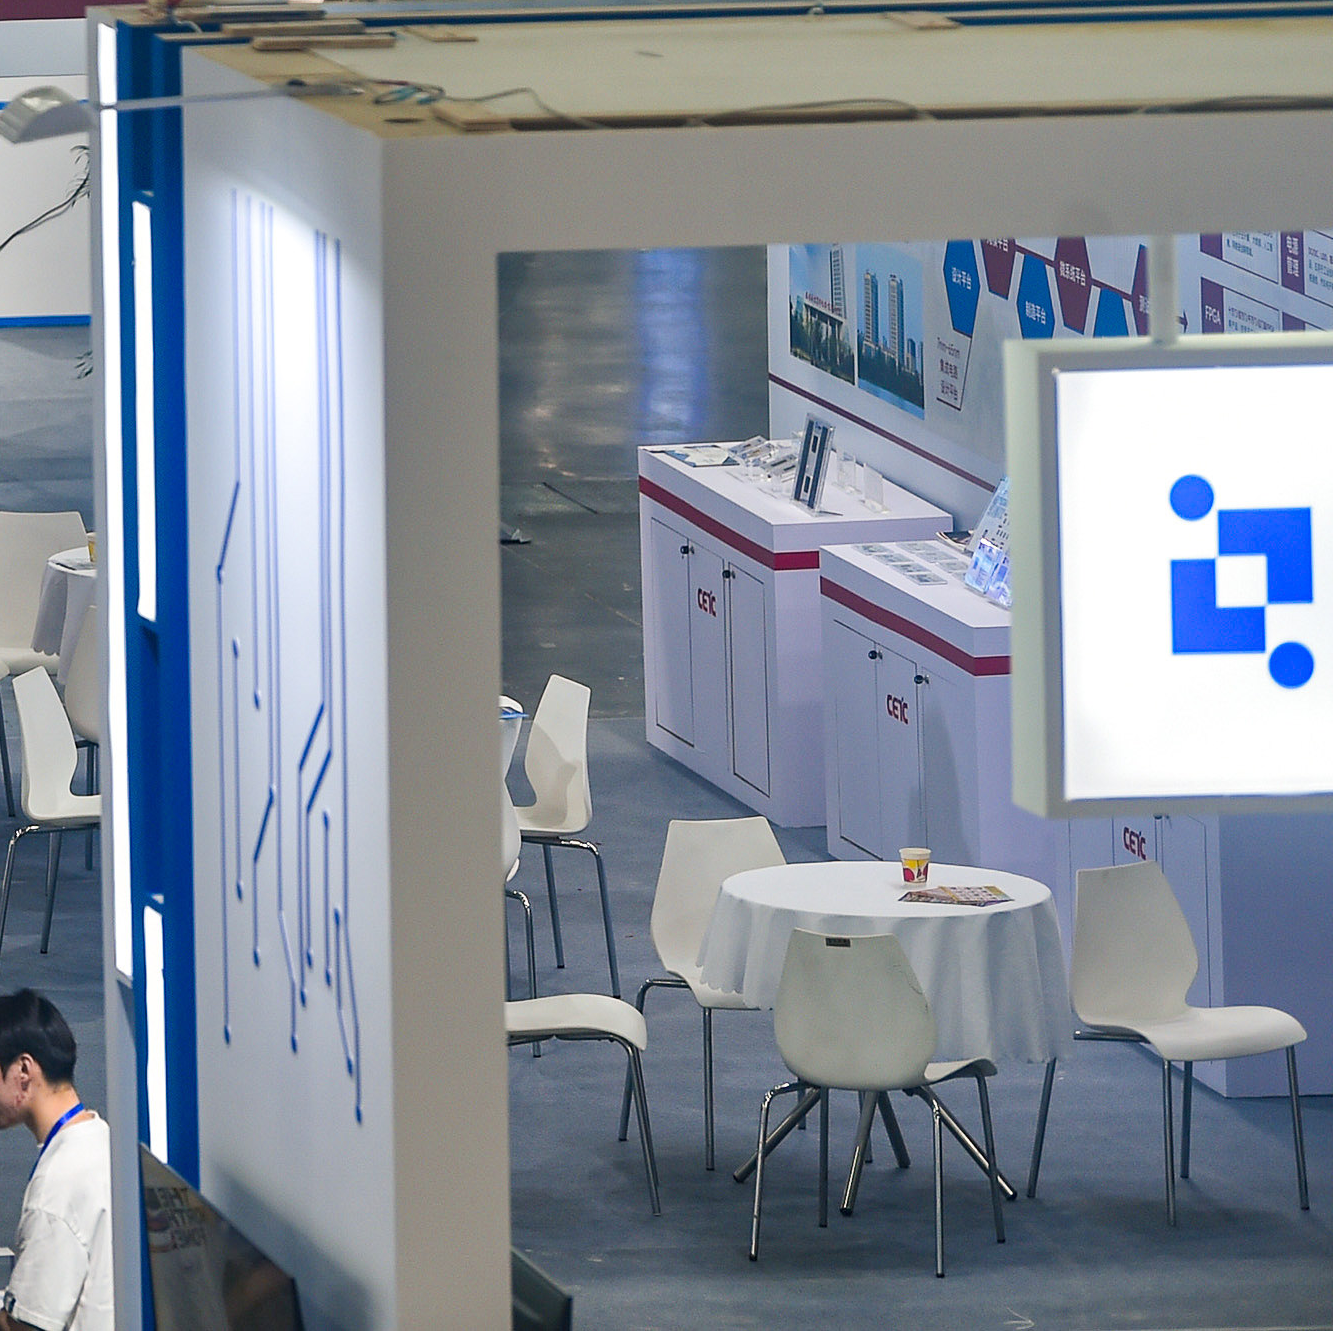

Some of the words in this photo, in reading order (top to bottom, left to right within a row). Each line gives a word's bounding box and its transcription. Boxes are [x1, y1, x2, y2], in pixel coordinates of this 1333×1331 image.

[1204, 305, 1222, 325] FPGA
[697, 587, 717, 618] CETC
[886, 693, 909, 725] CETC
[1122, 826, 1147, 861] CETC
